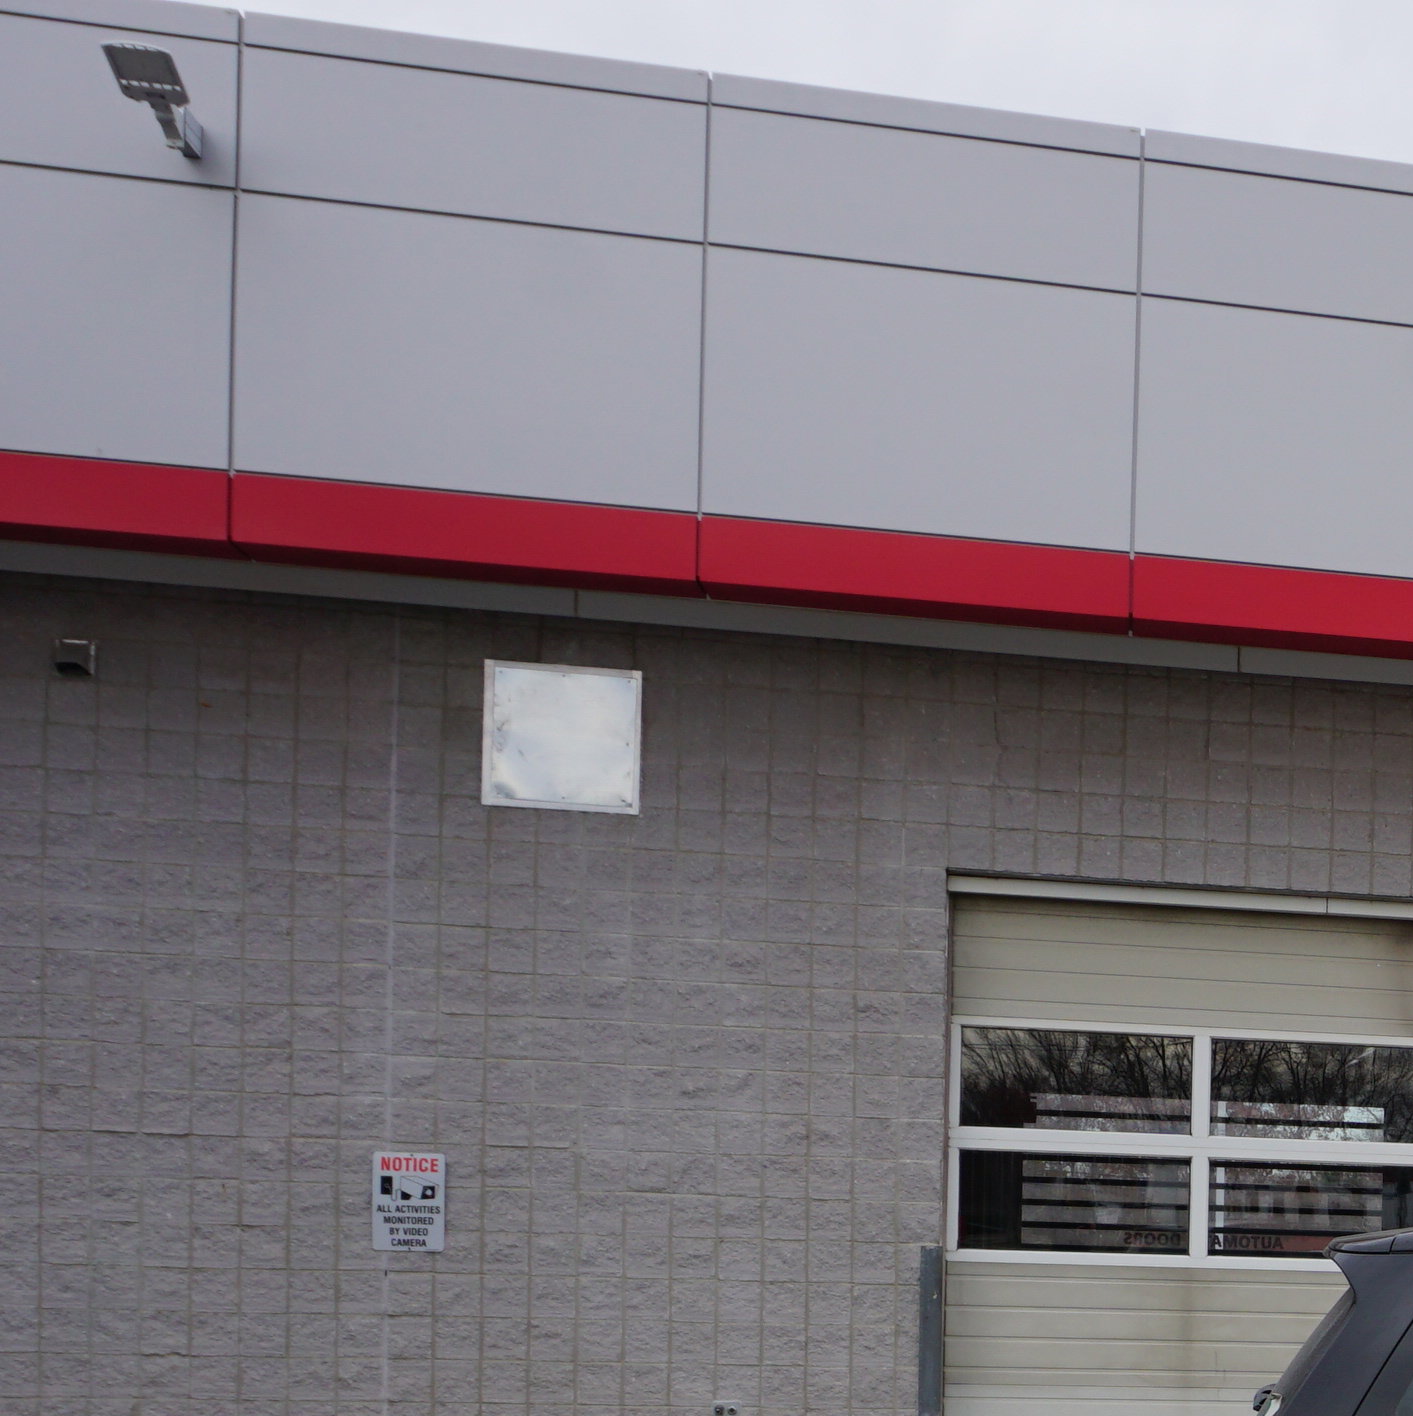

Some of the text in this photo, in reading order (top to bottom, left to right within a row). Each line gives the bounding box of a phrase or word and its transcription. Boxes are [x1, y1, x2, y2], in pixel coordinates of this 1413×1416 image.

[381, 1157, 439, 1172] NOTICE
[376, 1205, 441, 1214] ALL ACTIVITIES
[383, 1216, 434, 1225] MONITORED
[389, 1227, 429, 1236] BY VIDEO
[391, 1239, 427, 1247] CAMERA
